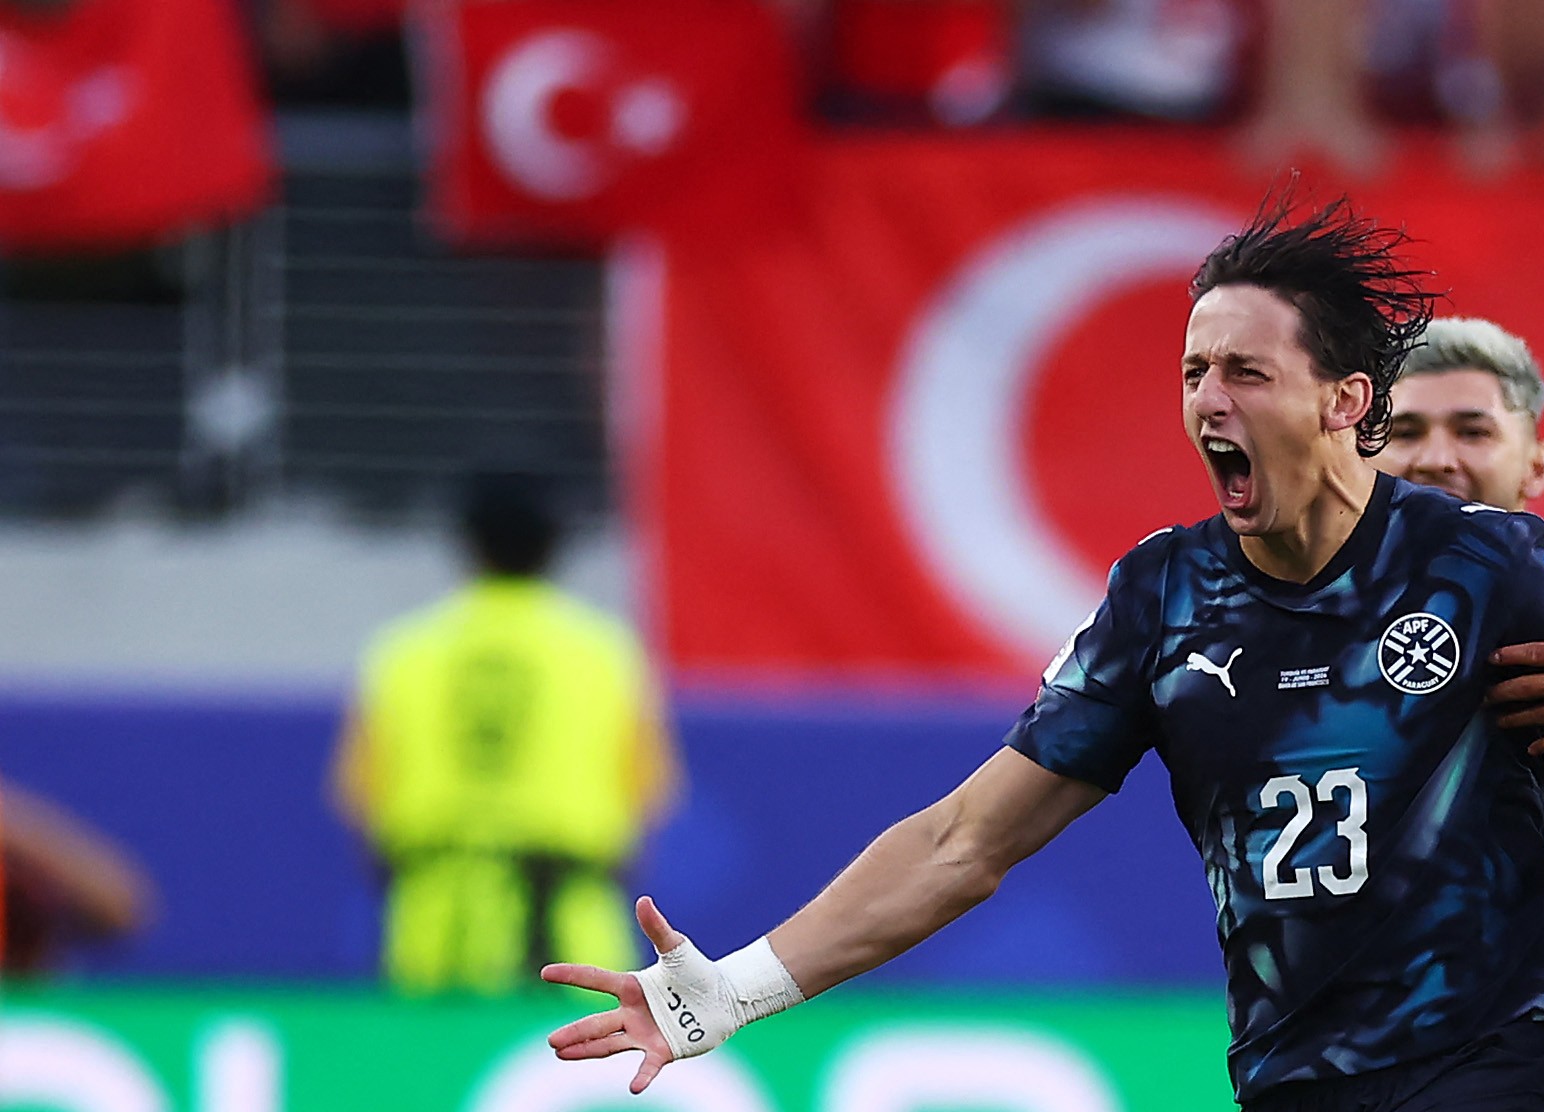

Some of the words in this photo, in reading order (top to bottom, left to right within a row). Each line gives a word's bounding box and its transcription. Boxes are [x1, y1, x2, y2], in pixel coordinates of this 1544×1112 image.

[1402, 618, 1430, 635] APF
[1401, 675, 1440, 690] PARAGUAY
[1259, 767, 1369, 900] 23
